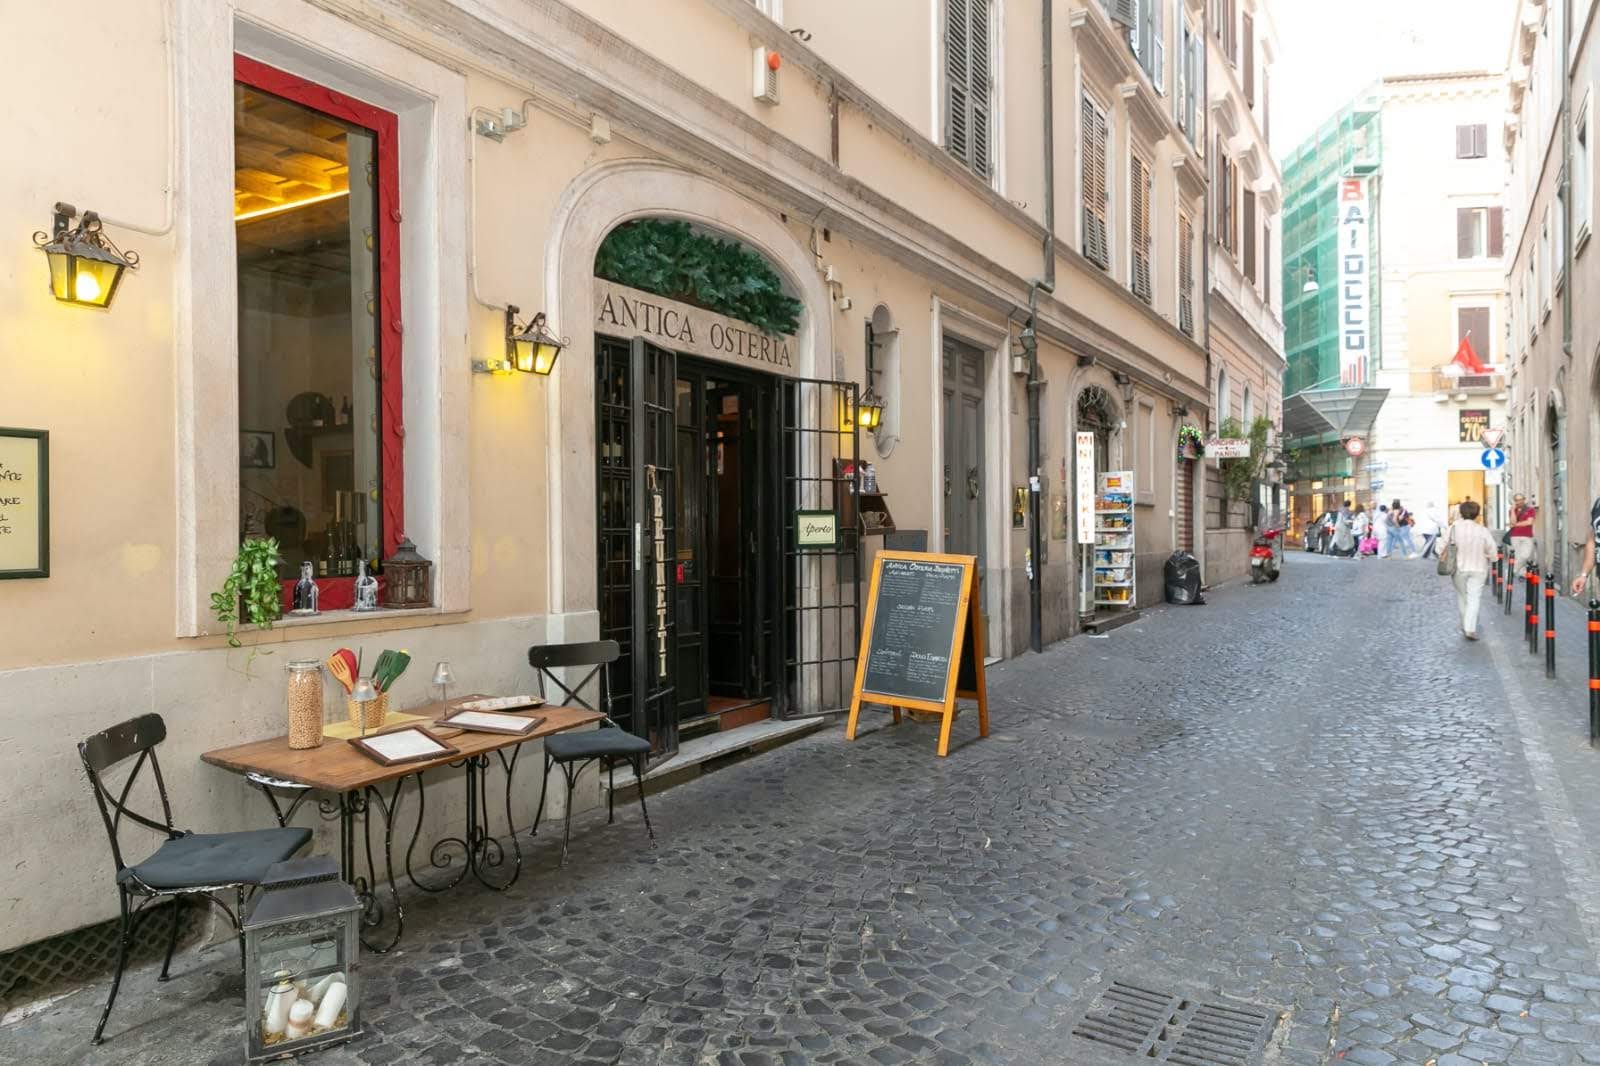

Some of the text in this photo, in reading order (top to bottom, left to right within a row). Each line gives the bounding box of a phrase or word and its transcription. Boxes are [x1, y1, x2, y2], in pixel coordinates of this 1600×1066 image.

[598, 293, 792, 367] ANTICA OSTERIA
[653, 495, 667, 676] BRUNETTI
